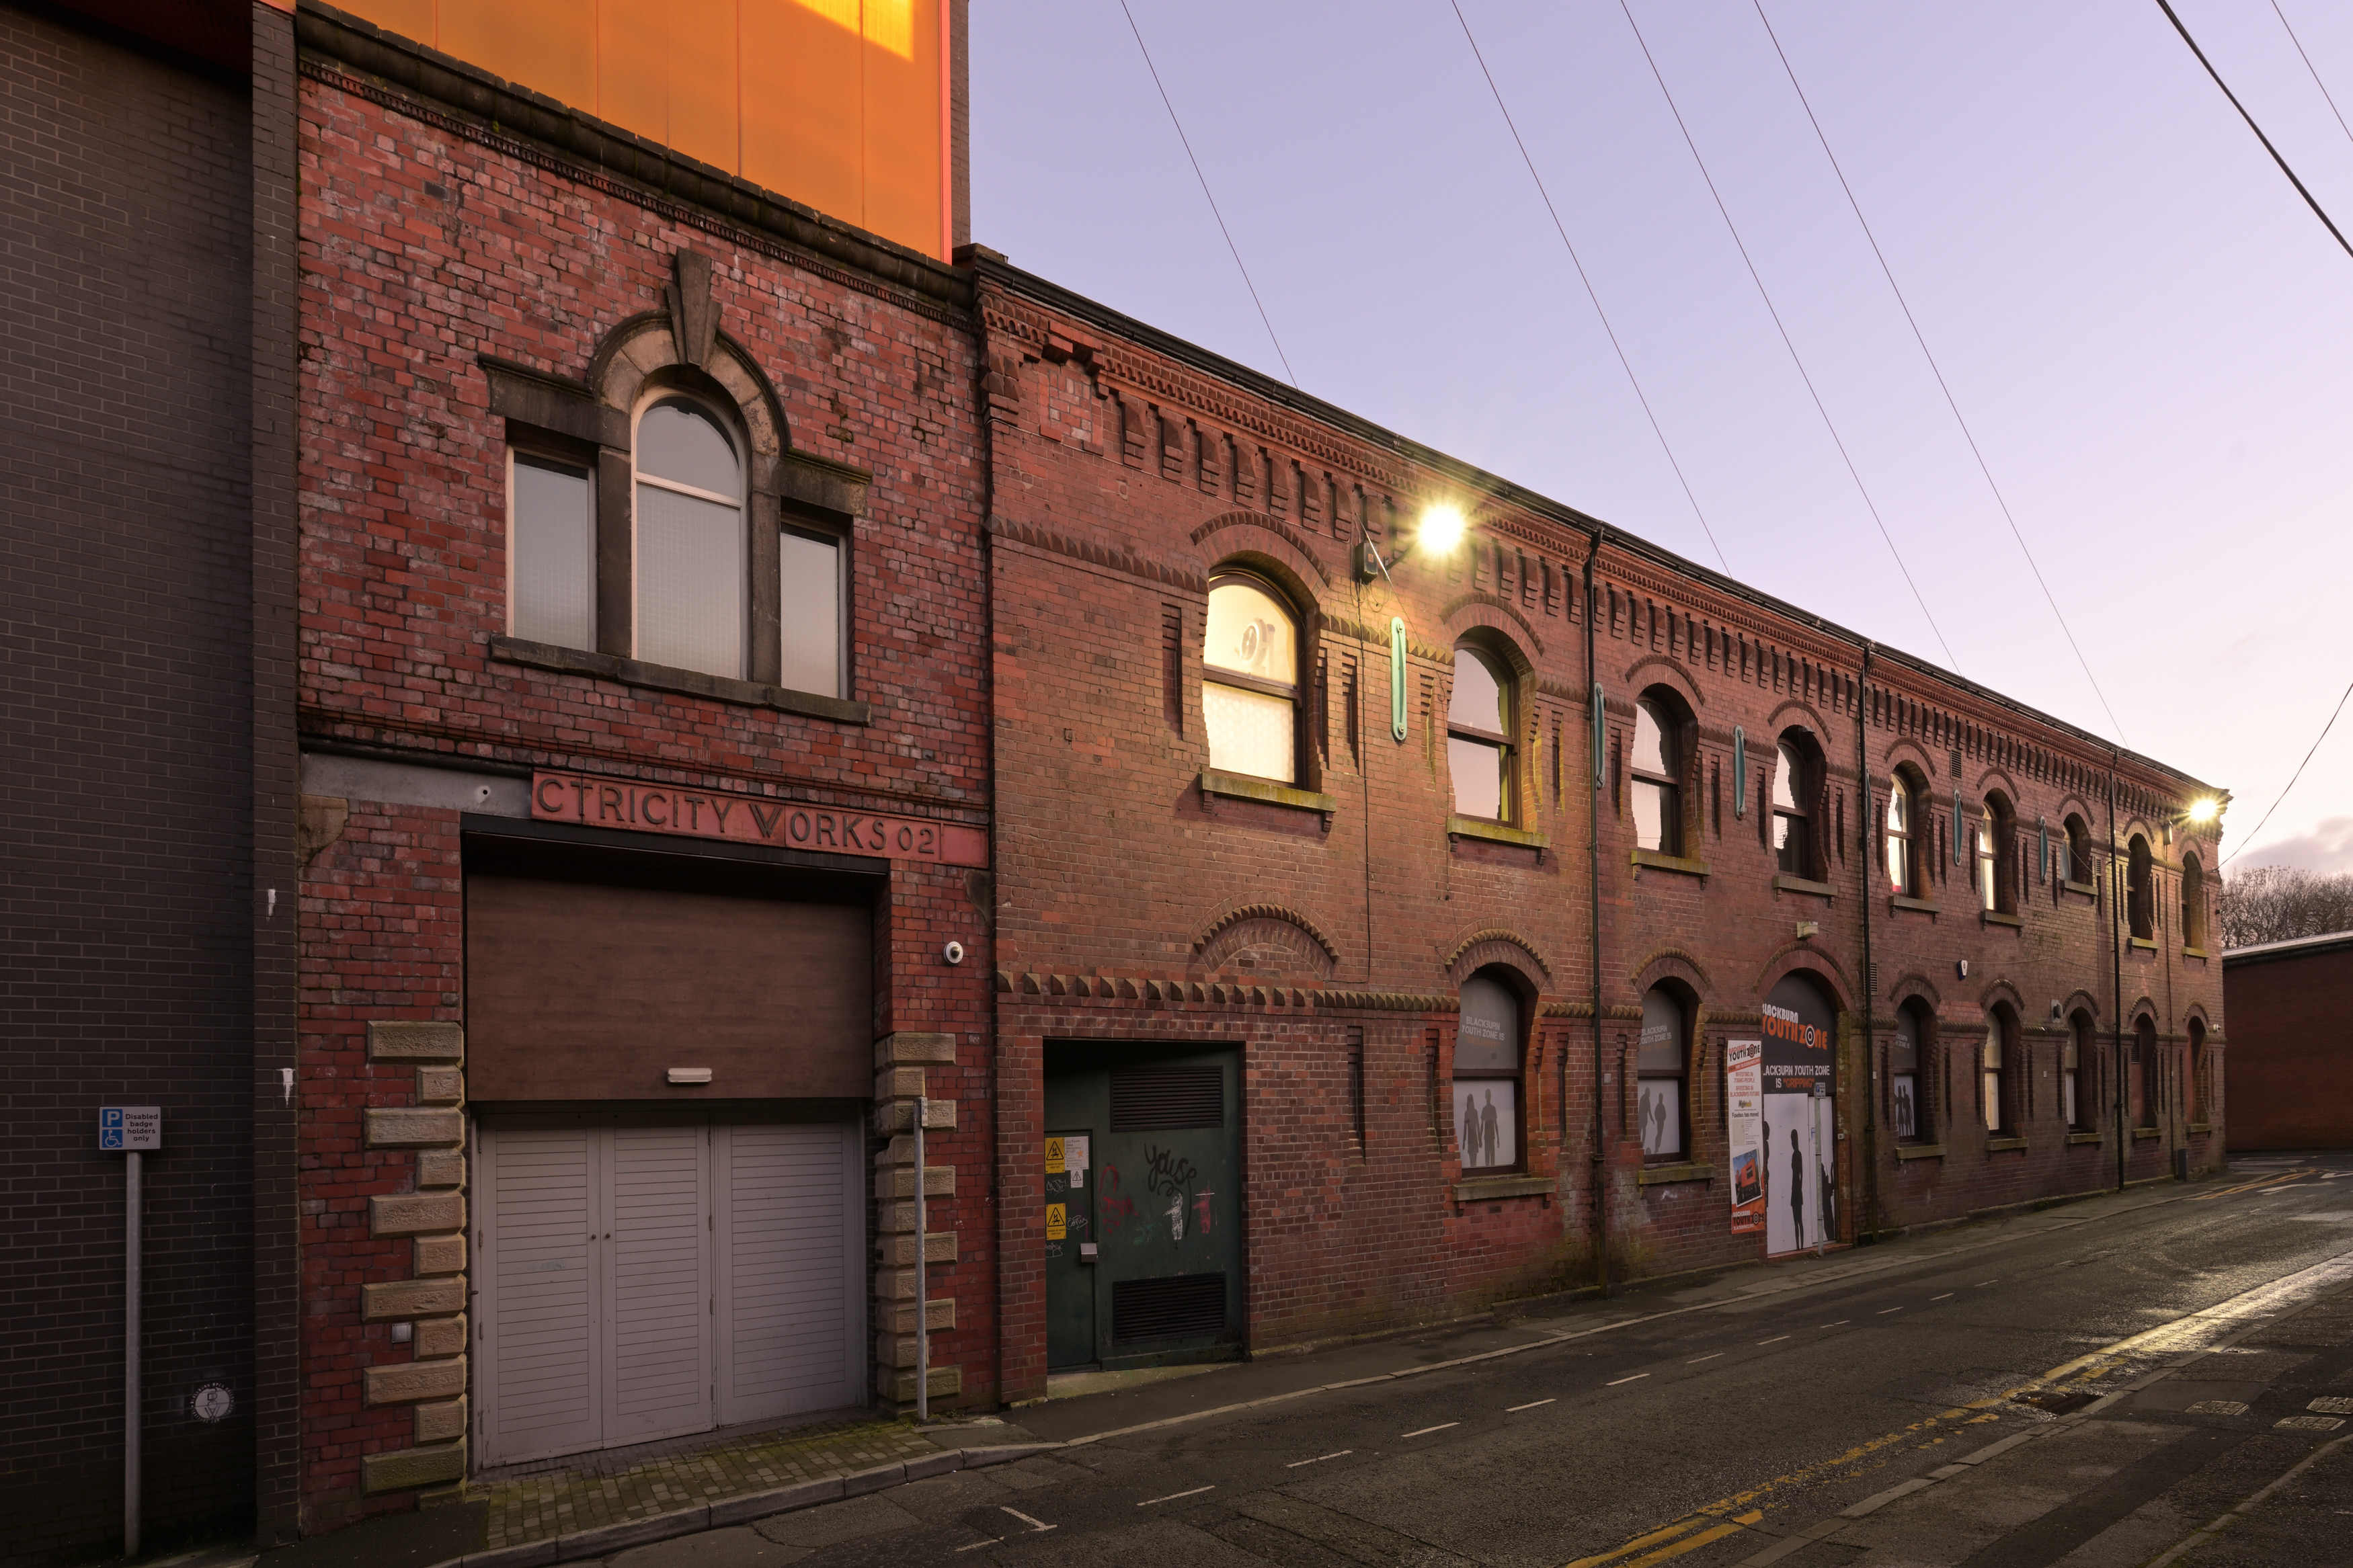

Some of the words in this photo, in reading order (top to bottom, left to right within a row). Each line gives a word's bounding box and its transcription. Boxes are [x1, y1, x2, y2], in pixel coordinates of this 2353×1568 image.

[538, 778, 733, 833] CTRICITY
[748, 803, 887, 850] WORKS
[898, 825, 934, 854] 02
[1466, 1016, 1501, 1031] BLACKBURN
[1462, 1024, 1481, 1036] YOUTH
[1482, 1029, 1498, 1040] ZONE
[1499, 1032, 1505, 1041] IS
[1639, 1036, 1654, 1045] OUTH
[1654, 1033, 1667, 1042] ZONE
[1667, 1032, 1672, 1040] IS
[1728, 1048, 1747, 1062] YOUTH
[1794, 1065, 1814, 1076] YOUTH
[1814, 1065, 1830, 1076] ZONE
[1776, 1077, 1782, 1089] IS
[107, 1111, 120, 1126] P
[1732, 1215, 1751, 1226] YOUTH
